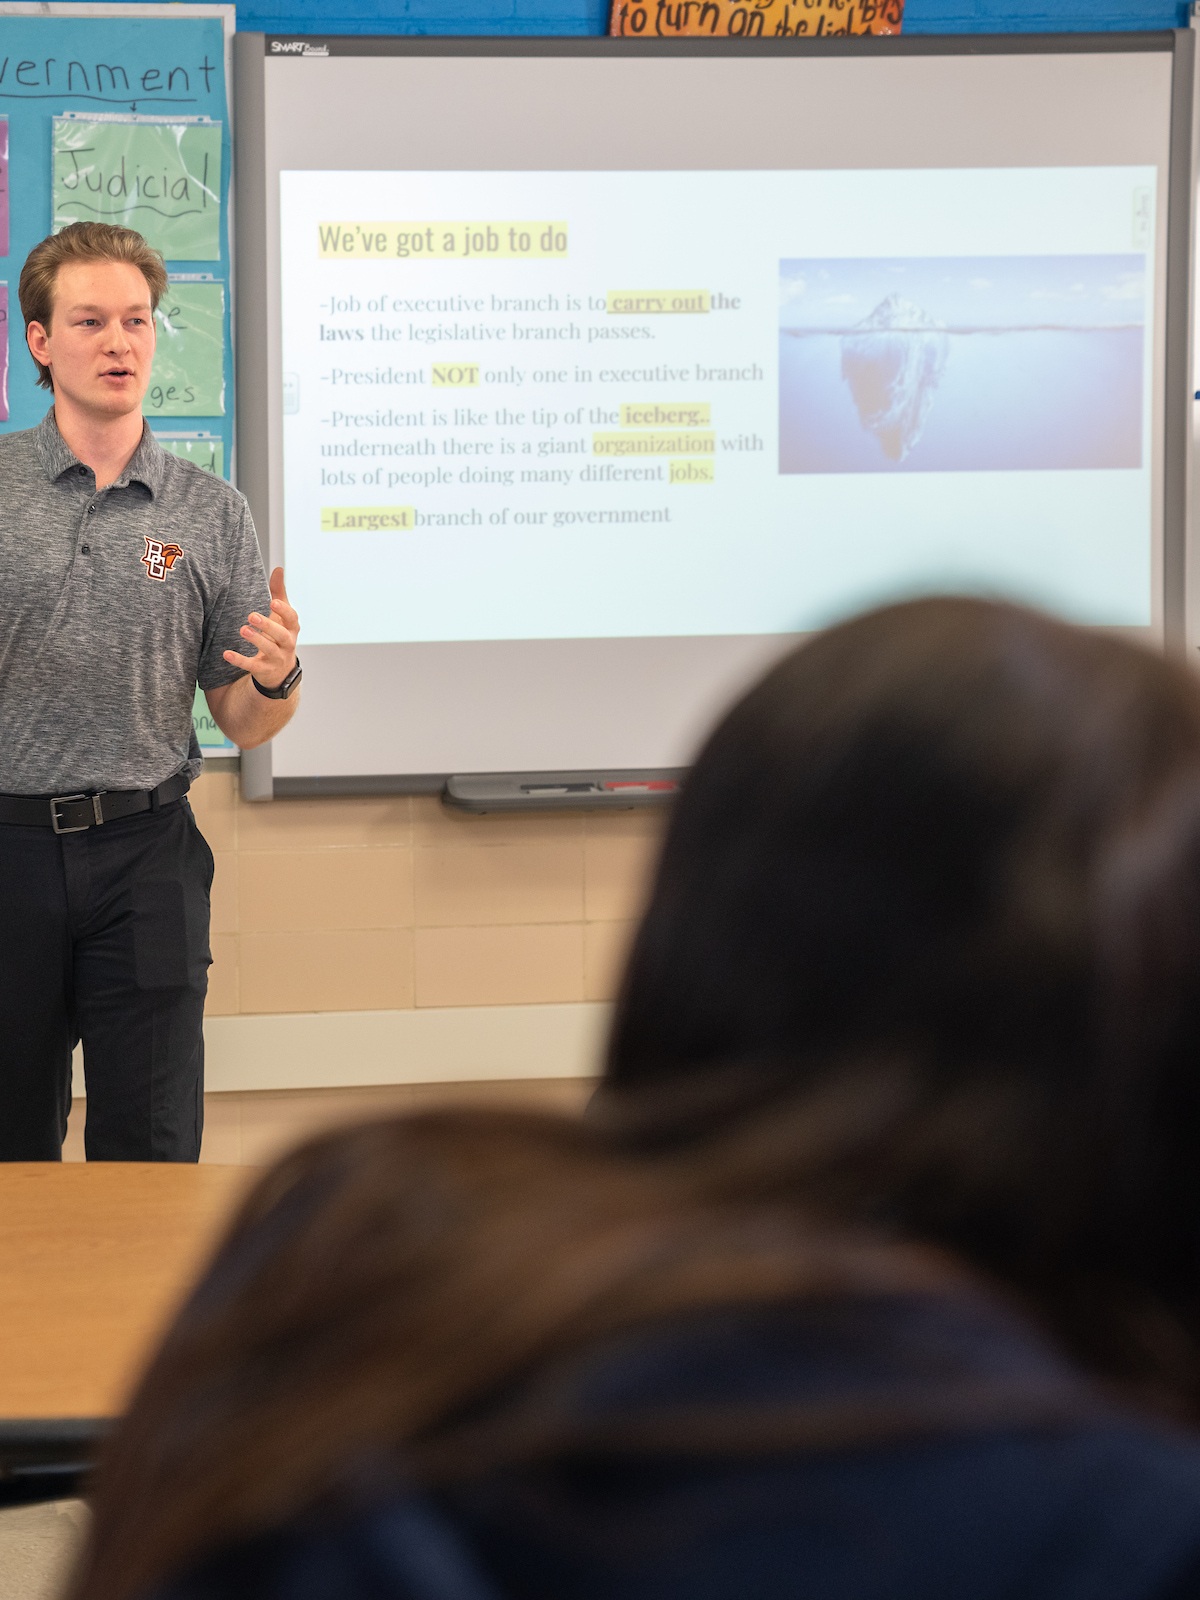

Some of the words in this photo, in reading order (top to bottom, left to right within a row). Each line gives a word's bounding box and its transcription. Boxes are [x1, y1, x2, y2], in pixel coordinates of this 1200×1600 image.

[619, 3, 648, 36] to
[656, 0, 720, 36] turn
[728, 8, 765, 36] on
[271, 41, 305, 52] SMART
[58, 147, 209, 207] Judicial
[396, 226, 435, 257] got
[442, 232, 456, 252] a
[462, 225, 500, 257] job
[508, 226, 532, 252] to
[540, 224, 568, 252] do
[367, 295, 388, 312] of
[392, 295, 485, 312] executive
[490, 293, 560, 312] branch
[566, 293, 582, 311] is
[588, 295, 607, 311] to
[612, 296, 667, 313] carry
[671, 294, 705, 312] out
[710, 292, 742, 311] the
[319, 323, 365, 341] laws
[371, 323, 402, 341] the
[408, 323, 507, 345] legislative
[512, 322, 581, 341] branch
[587, 324, 656, 344] passes.
[431, 366, 480, 384] NOT
[484, 366, 526, 387] only
[532, 368, 568, 383] one
[574, 365, 593, 382] in
[598, 364, 690, 382] executive
[695, 363, 764, 381] branch
[150, 383, 196, 409] ges
[432, 408, 448, 426] is
[453, 408, 488, 426] like
[495, 407, 526, 426] the
[532, 407, 558, 429] tip
[564, 407, 584, 425] of
[589, 407, 620, 425] the
[320, 438, 436, 457] underneath
[443, 437, 494, 455] there
[500, 437, 516, 455] is
[521, 441, 532, 454] a
[537, 437, 588, 458] giant
[592, 435, 715, 457] organization
[721, 433, 764, 452] with
[320, 468, 357, 486] lots
[362, 467, 383, 485] of
[387, 466, 453, 488] people
[458, 465, 515, 486] doing
[520, 468, 574, 486] many
[579, 463, 665, 483] different
[668, 462, 715, 484] jobs.
[414, 508, 483, 526] branch
[488, 507, 510, 525] of
[514, 510, 548, 525] our
[552, 505, 672, 527] government
